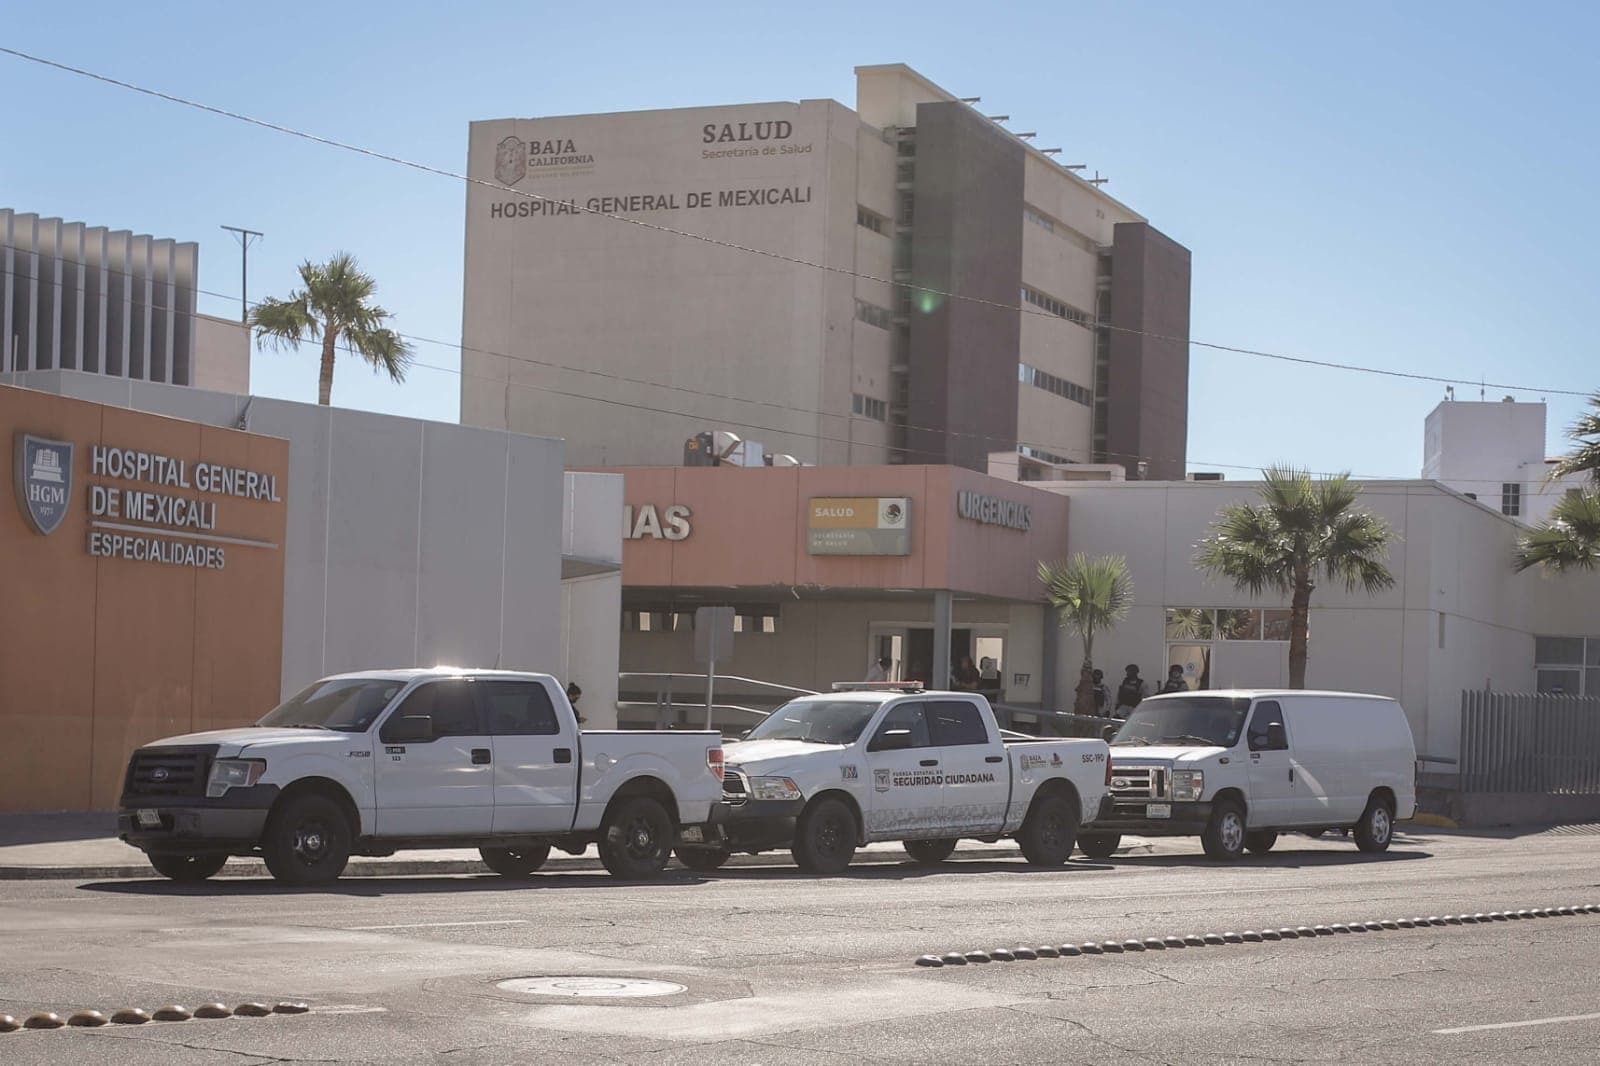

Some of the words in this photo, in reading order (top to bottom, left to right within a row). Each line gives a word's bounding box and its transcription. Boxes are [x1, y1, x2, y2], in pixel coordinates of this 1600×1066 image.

[703, 120, 792, 143] SALUD
[529, 139, 576, 155] BAJA
[762, 146, 776, 156] de
[780, 143, 813, 155] Salud
[528, 155, 594, 167] CALIFORNIA
[491, 200, 581, 219] HOSPITAL
[587, 194, 680, 214] GENERAL
[687, 192, 712, 209] DE
[718, 187, 812, 207] MEXICALI
[92, 445, 190, 489] HOSPITAL
[195, 463, 281, 503] GENERAL
[30, 483, 65, 504] HGM
[91, 486, 120, 518] DE
[125, 494, 216, 530] MEXICALI
[815, 507, 854, 517] SALUD
[959, 491, 1032, 530] URGENCIAS
[89, 532, 225, 569] ESPECIALIDADES
[893, 775, 943, 787] SEGURIDAD
[944, 773, 995, 785] CIUDADANA
